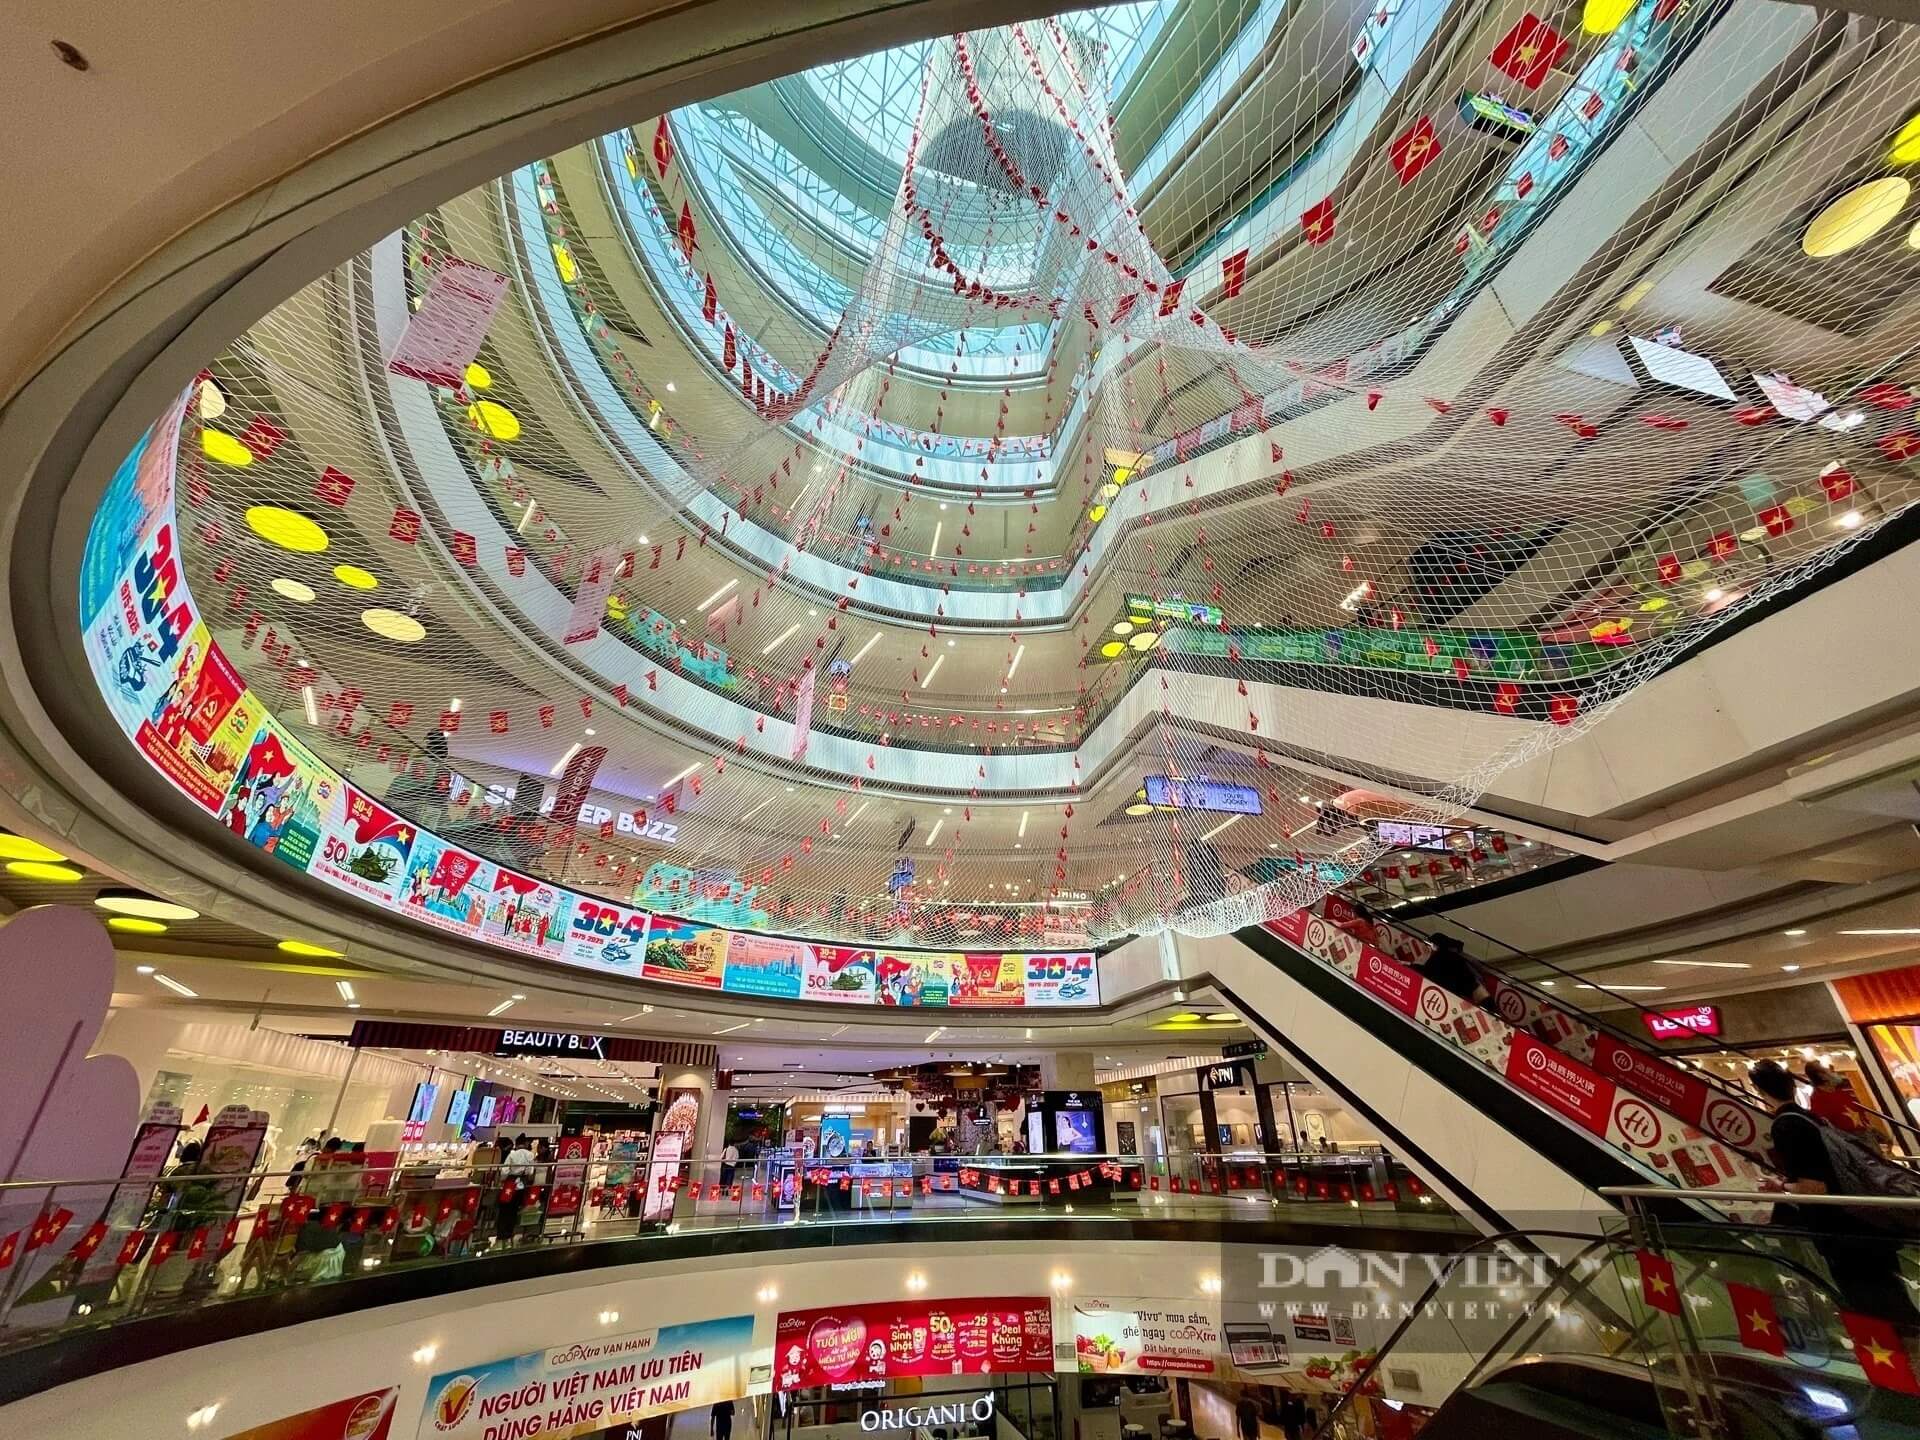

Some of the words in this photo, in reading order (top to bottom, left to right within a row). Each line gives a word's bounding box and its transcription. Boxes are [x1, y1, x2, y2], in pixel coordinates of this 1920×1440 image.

[617, 811, 678, 844] BUZZ
[502, 1030, 565, 1048] BEAUTY
[974, 1315, 988, 1327] 29
[1133, 1311, 1162, 1322] "Vivu"
[1166, 1314, 1185, 1324] mua
[1188, 1312, 1210, 1326] sắm,
[891, 1330, 912, 1341] Sinh
[1001, 1324, 1021, 1335] Deal
[1122, 1325, 1140, 1339] ghé
[1142, 1328, 1165, 1341] ngay
[603, 1342, 623, 1357] VẠN
[624, 1337, 651, 1352] HẠNH
[991, 1332, 1022, 1347] Khủng
[479, 1379, 547, 1420] NGƯỜI
[552, 1371, 589, 1401] VIỆT
[592, 1364, 636, 1391] NAM
[640, 1356, 663, 1380] ƯU
[668, 1350, 703, 1374] TIÊN
[483, 1414, 542, 1440] DÙNG
[546, 1397, 604, 1431] HÀNG
[610, 1387, 646, 1416] VIỆT
[649, 1381, 691, 1407] NAM
[861, 1403, 965, 1432] ORIGANI
